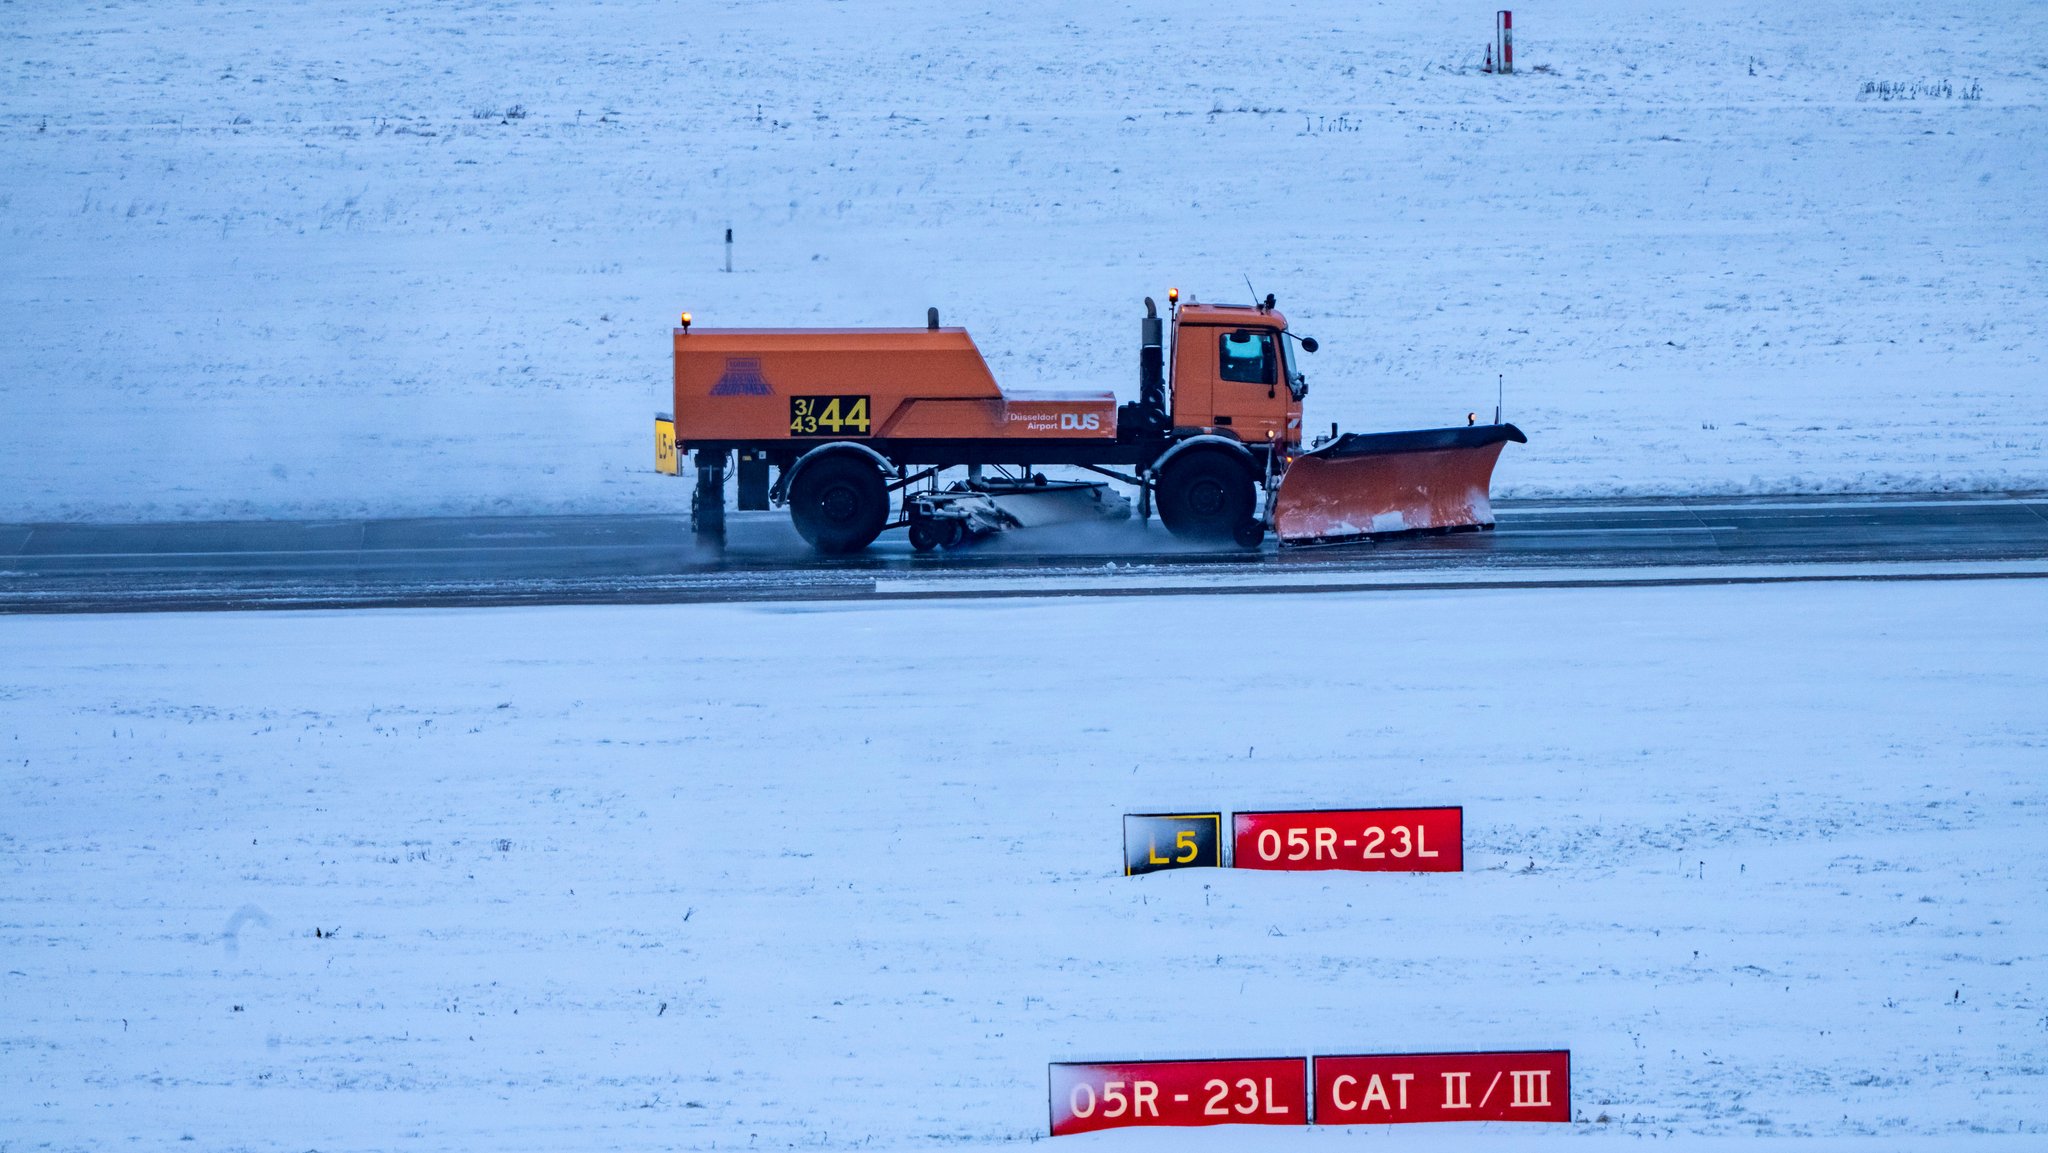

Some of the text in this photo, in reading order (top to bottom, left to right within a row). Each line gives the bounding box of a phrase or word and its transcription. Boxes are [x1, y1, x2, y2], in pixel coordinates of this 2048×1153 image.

[795, 399, 815, 416] 3/
[818, 398, 870, 432] 44
[790, 416, 818, 433] 43
[1010, 412, 1058, 421] Düsseldorf
[1061, 413, 1100, 430] DUS
[1028, 422, 1058, 431] Airport
[1149, 831, 1198, 864] L5
[1258, 825, 1439, 861] 05R-23L
[1332, 1073, 1415, 1111] CAT
